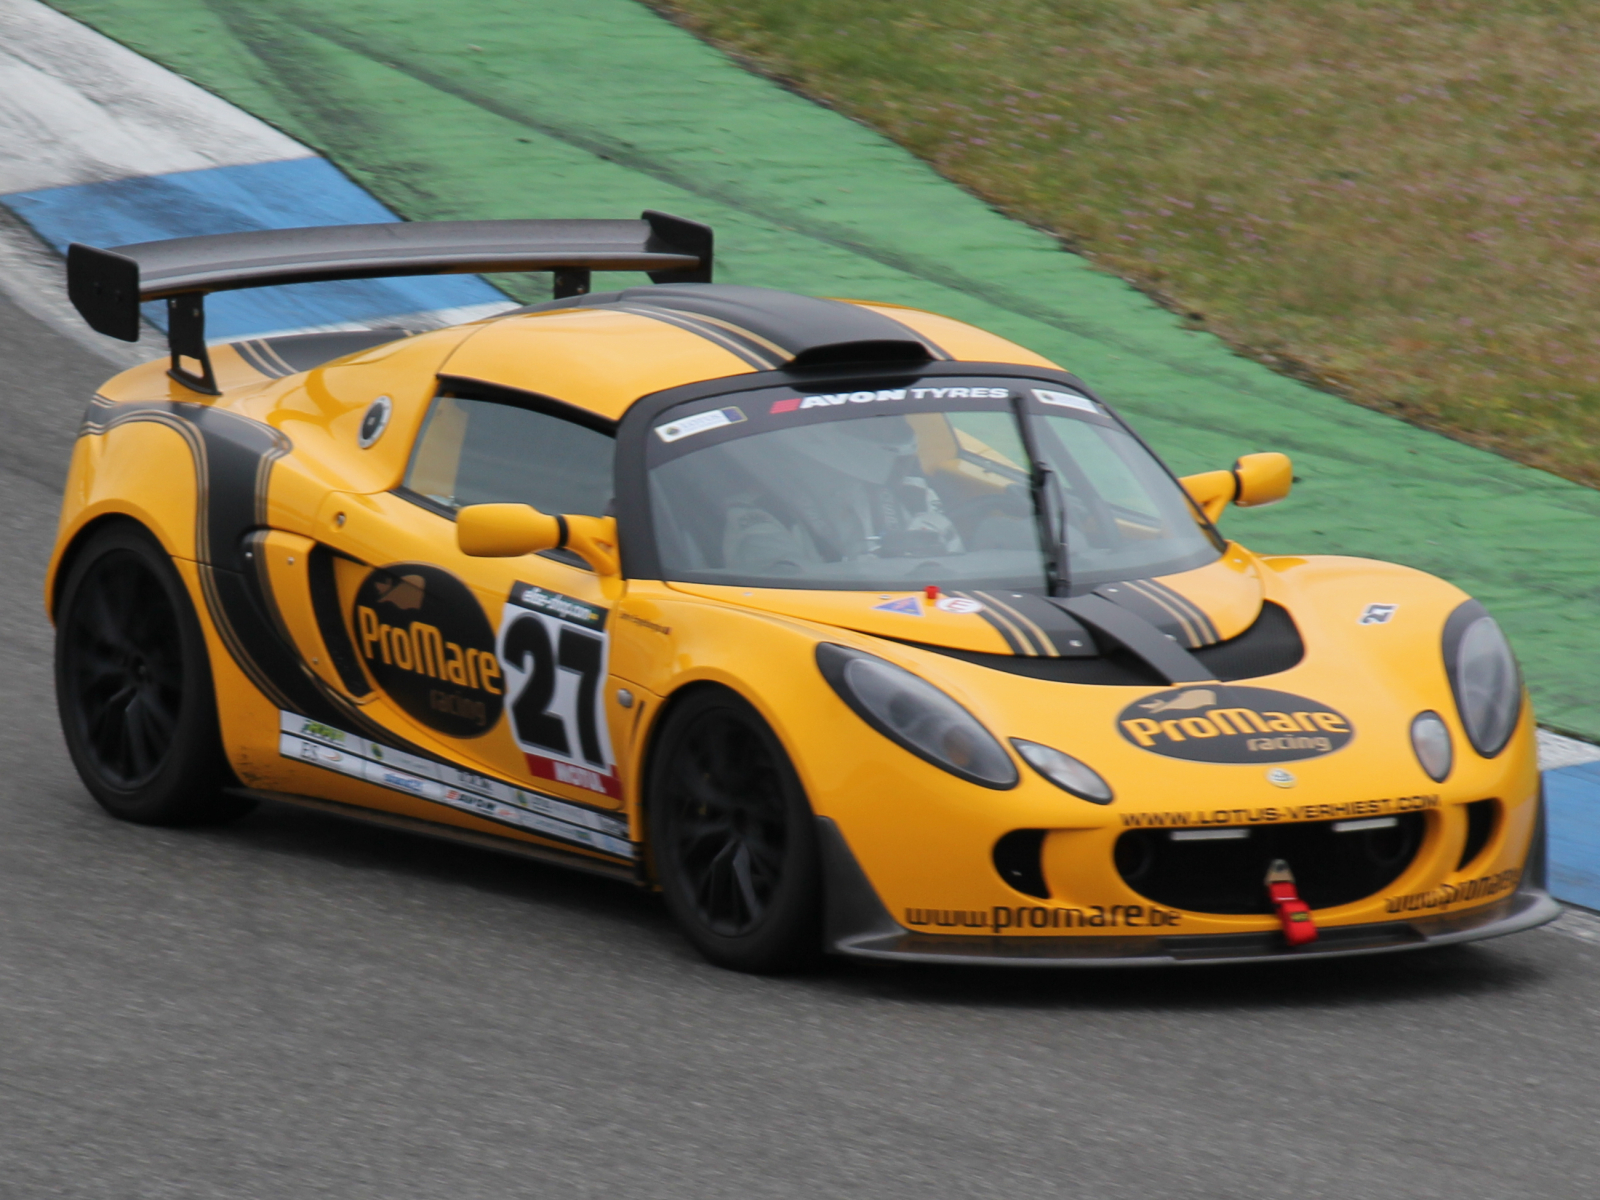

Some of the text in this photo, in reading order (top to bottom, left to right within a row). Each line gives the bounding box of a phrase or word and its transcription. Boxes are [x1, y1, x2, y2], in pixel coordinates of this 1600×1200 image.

[800, 386, 1009, 409] AVON TYRES
[1362, 604, 1395, 624] 27
[358, 605, 502, 695] ProMare
[503, 615, 607, 770] 27
[1120, 707, 1351, 747] ProMare
[1246, 733, 1332, 752] racing
[906, 903, 1182, 934] www.promare.be
